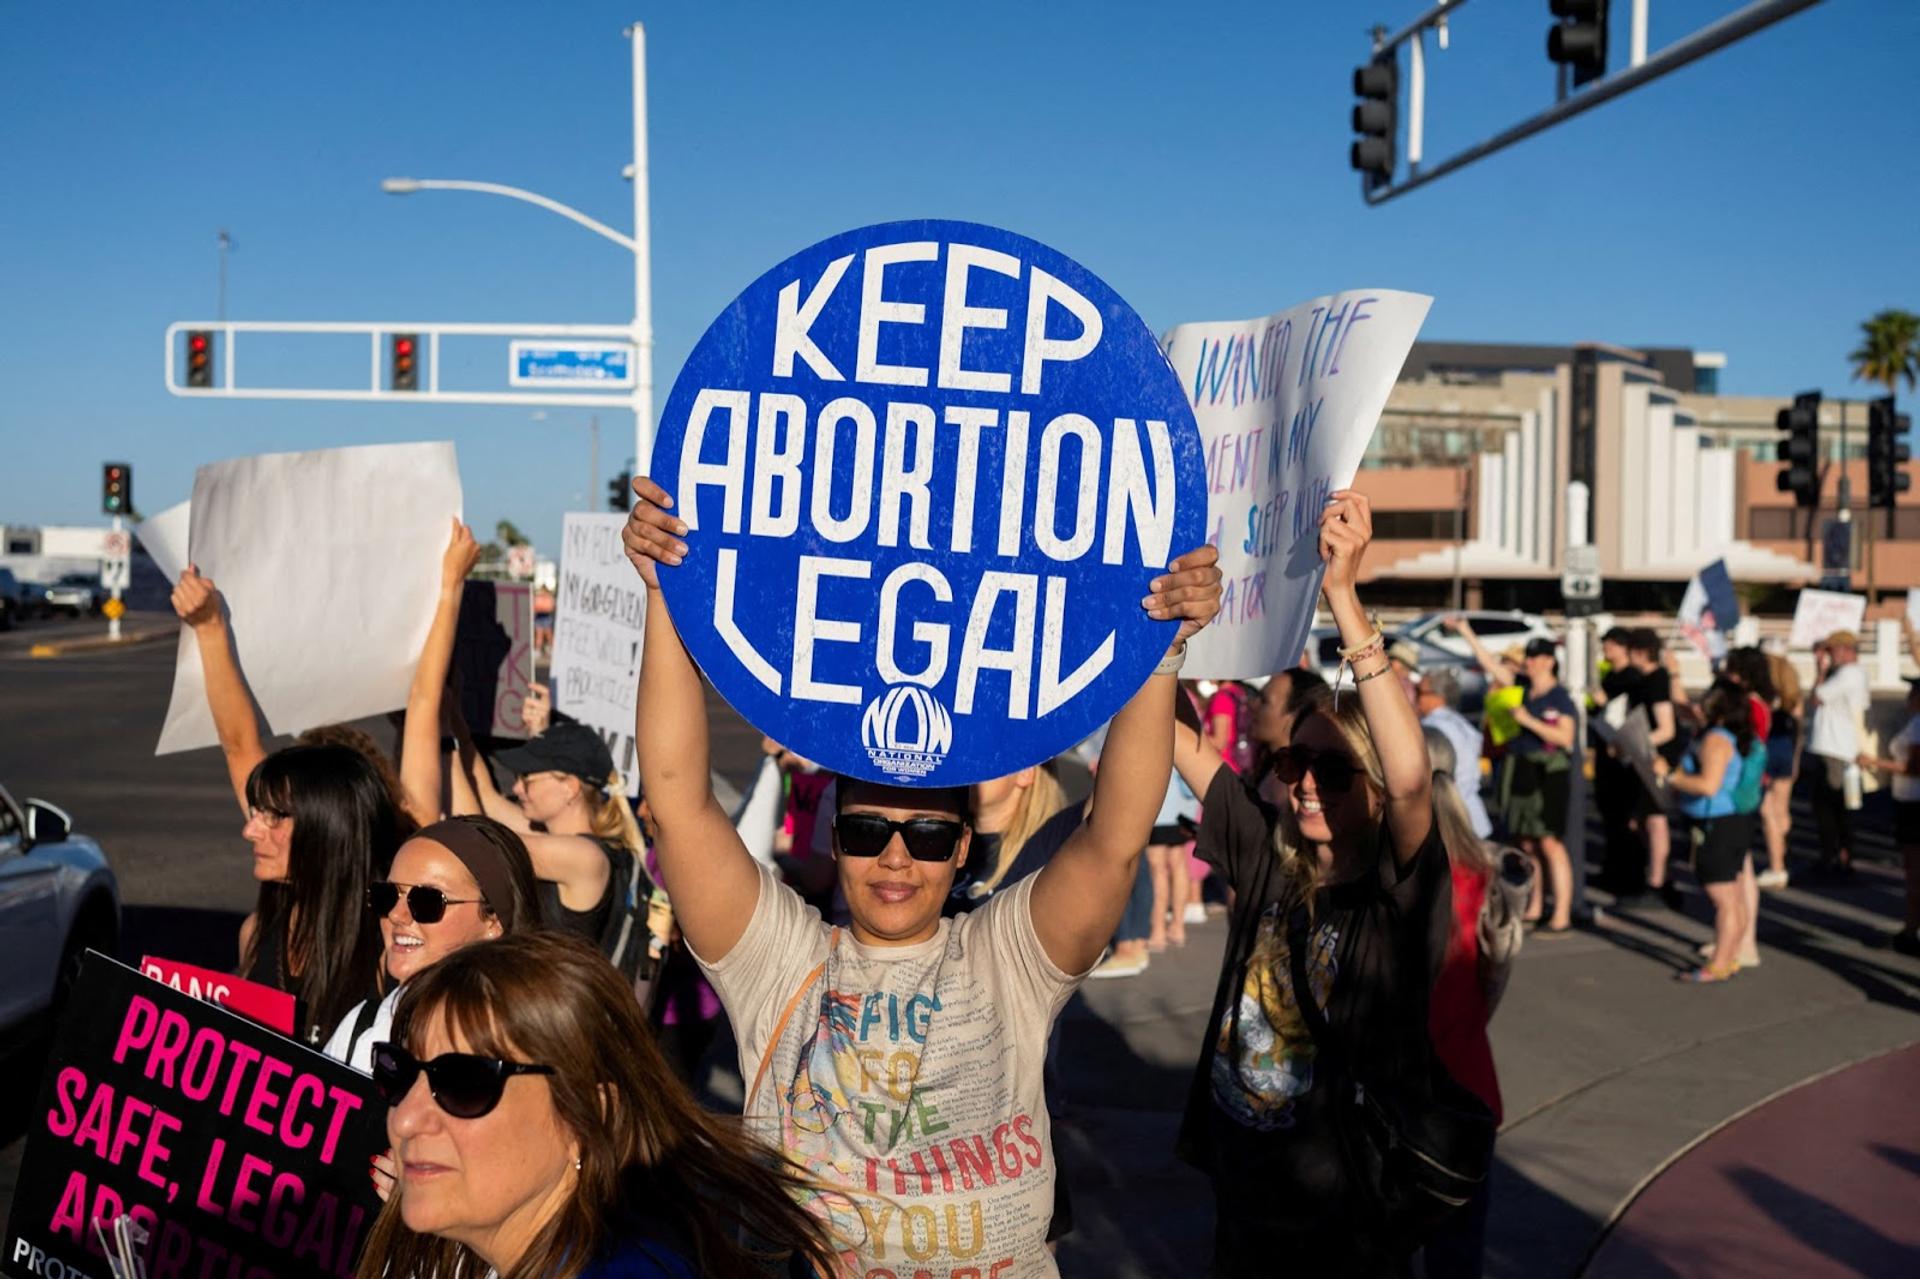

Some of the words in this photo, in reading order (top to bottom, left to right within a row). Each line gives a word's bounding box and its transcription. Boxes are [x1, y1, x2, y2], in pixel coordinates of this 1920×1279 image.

[772, 241, 1104, 396] KEEP
[1194, 319, 1292, 410] WANTED
[1298, 298, 1379, 388] THE
[1287, 397, 1324, 472] MY
[677, 388, 1176, 569] ABORTION
[1243, 490, 1290, 558] SLEEP
[1211, 570, 1267, 626] ATOR
[713, 547, 1116, 720] LEGAL
[862, 686, 952, 755] NOW
[867, 750, 942, 763] NATIONAL
[873, 758, 935, 771] ORGANIZATION
[898, 767, 926, 776] WOMEN
[859, 990, 942, 1044] FIG
[113, 994, 363, 1165] PROTECT
[858, 1050, 922, 1102] FO
[858, 1086, 950, 1150] THE
[48, 1067, 182, 1203] SAFE,
[196, 1138, 366, 1277] LEGAL
[865, 1114, 1042, 1195] THINGS
[858, 1200, 984, 1261] YOU
